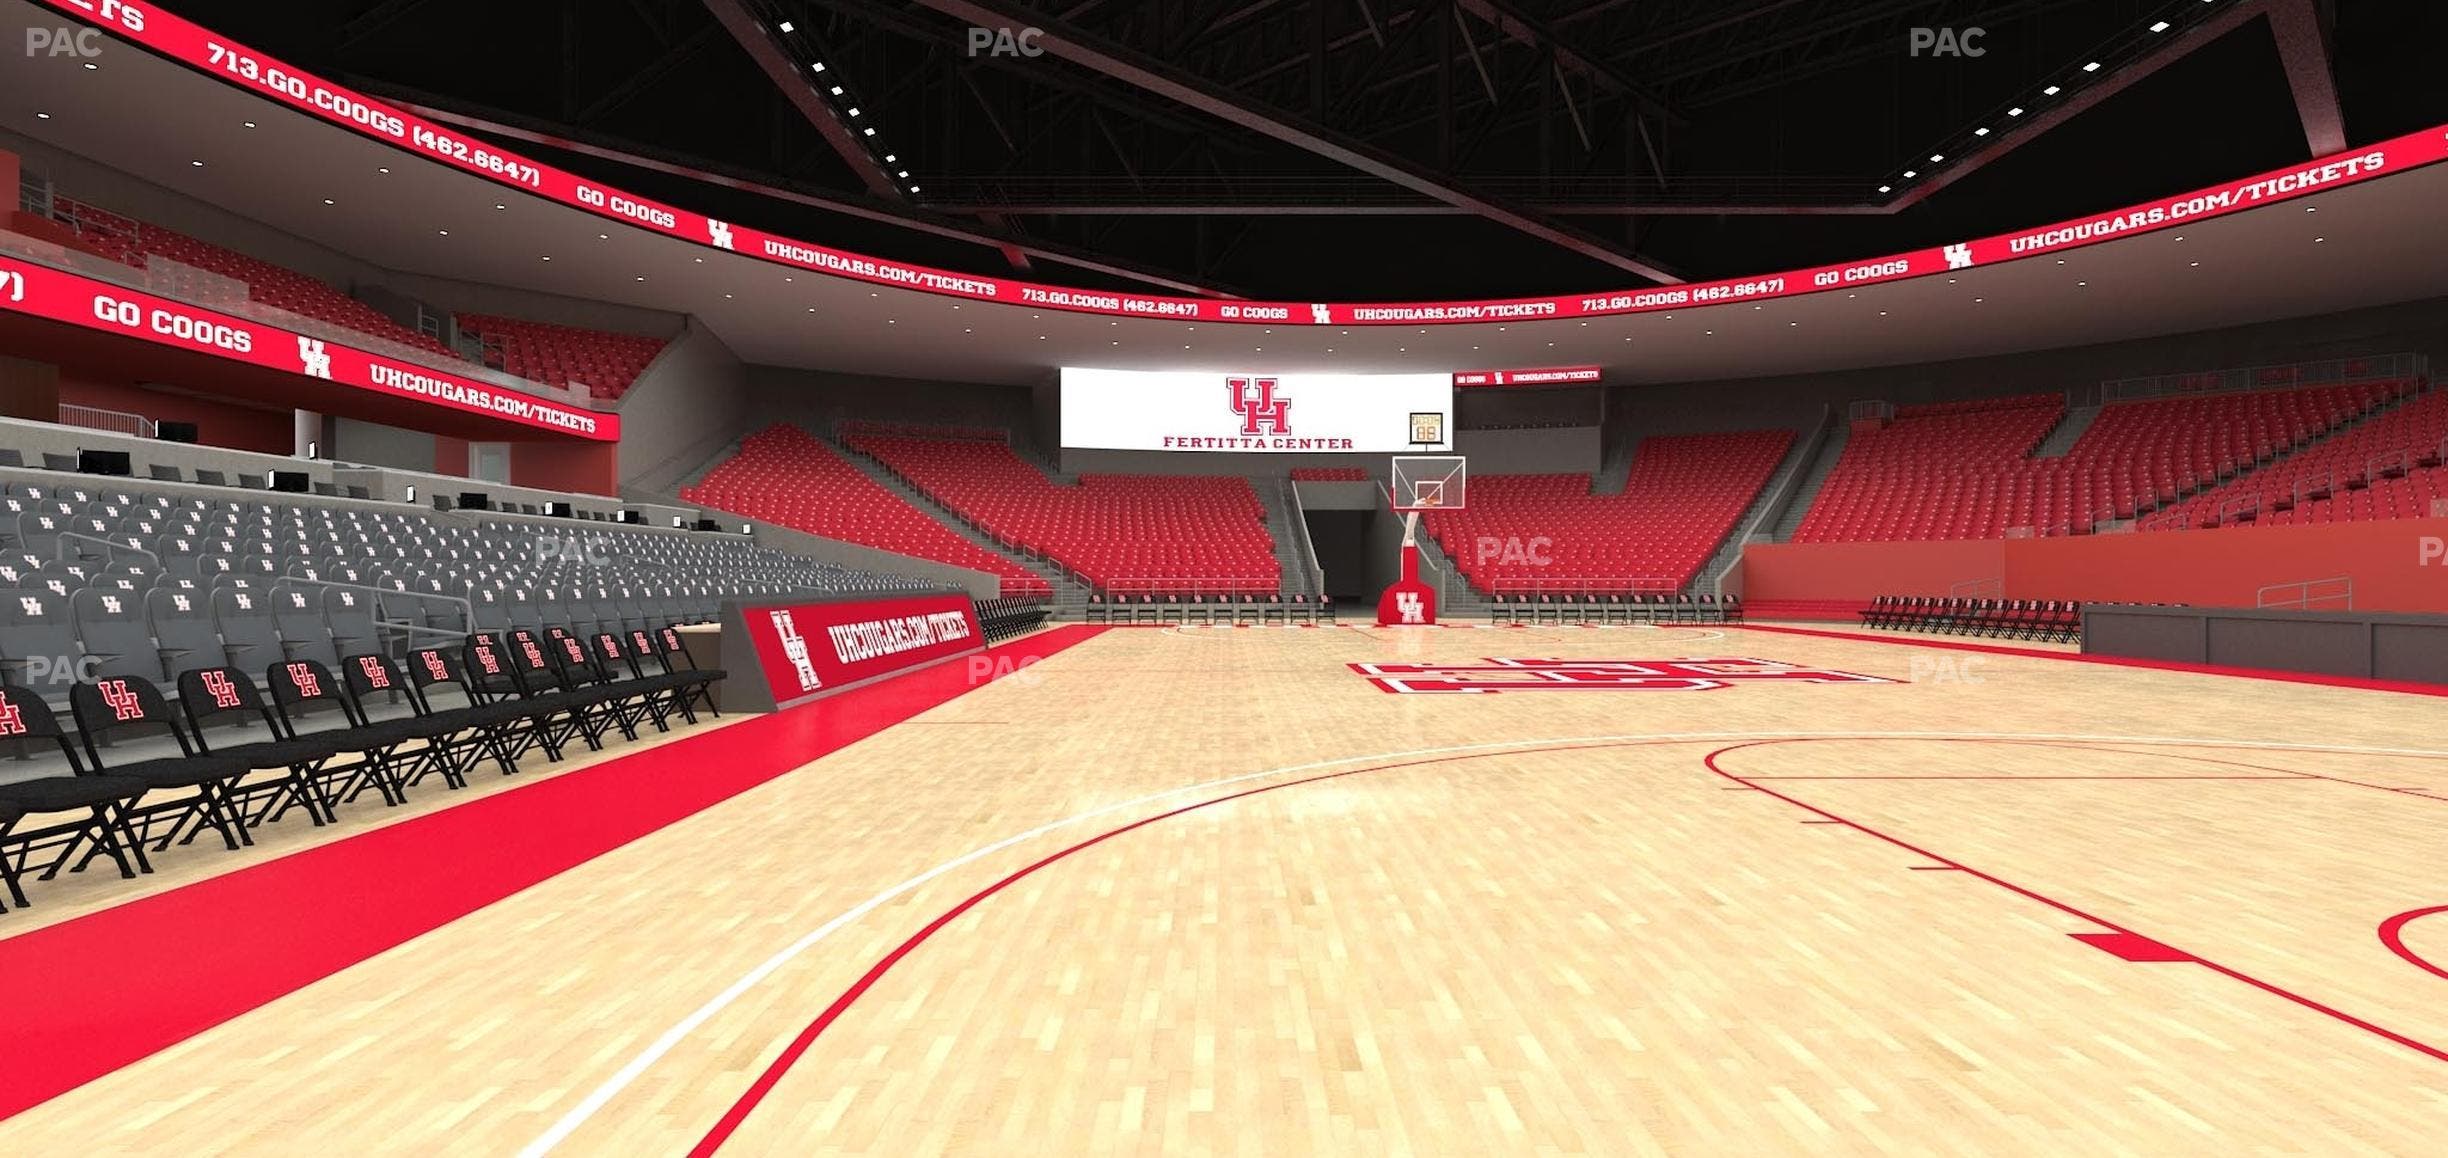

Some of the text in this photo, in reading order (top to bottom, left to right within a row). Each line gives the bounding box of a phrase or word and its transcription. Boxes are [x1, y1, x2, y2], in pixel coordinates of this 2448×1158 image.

[206, 42, 541, 187] 713.GO.COOGS (462.6647)
[576, 185, 675, 229] GO COOGS
[2009, 151, 2385, 253] UHCOUGARS.COM/TICKETS
[764, 240, 996, 297] UHCOUGARS.COM/TICKETS
[1814, 260, 1909, 286] GO COOGS
[1022, 288, 1120, 310] 713.GO.COOGS
[1220, 305, 1289, 320] GO COOGS
[1353, 302, 1556, 320] UHCOUGARS.COM/TICKETS
[1582, 289, 1688, 312] 713.GO.COOGS
[93, 295, 252, 353] GO COOGS
[370, 363, 596, 433] UHCOUGARS.COM/TICKETS
[1226, 378, 1291, 436] UH
[1163, 437, 1354, 449] FERTITTA CENTER
[827, 610, 971, 665] UHCOUGARS.COM/TICKETS
[99, 680, 144, 720] UH
[201, 671, 241, 708] UH
[287, 663, 321, 697] UH
